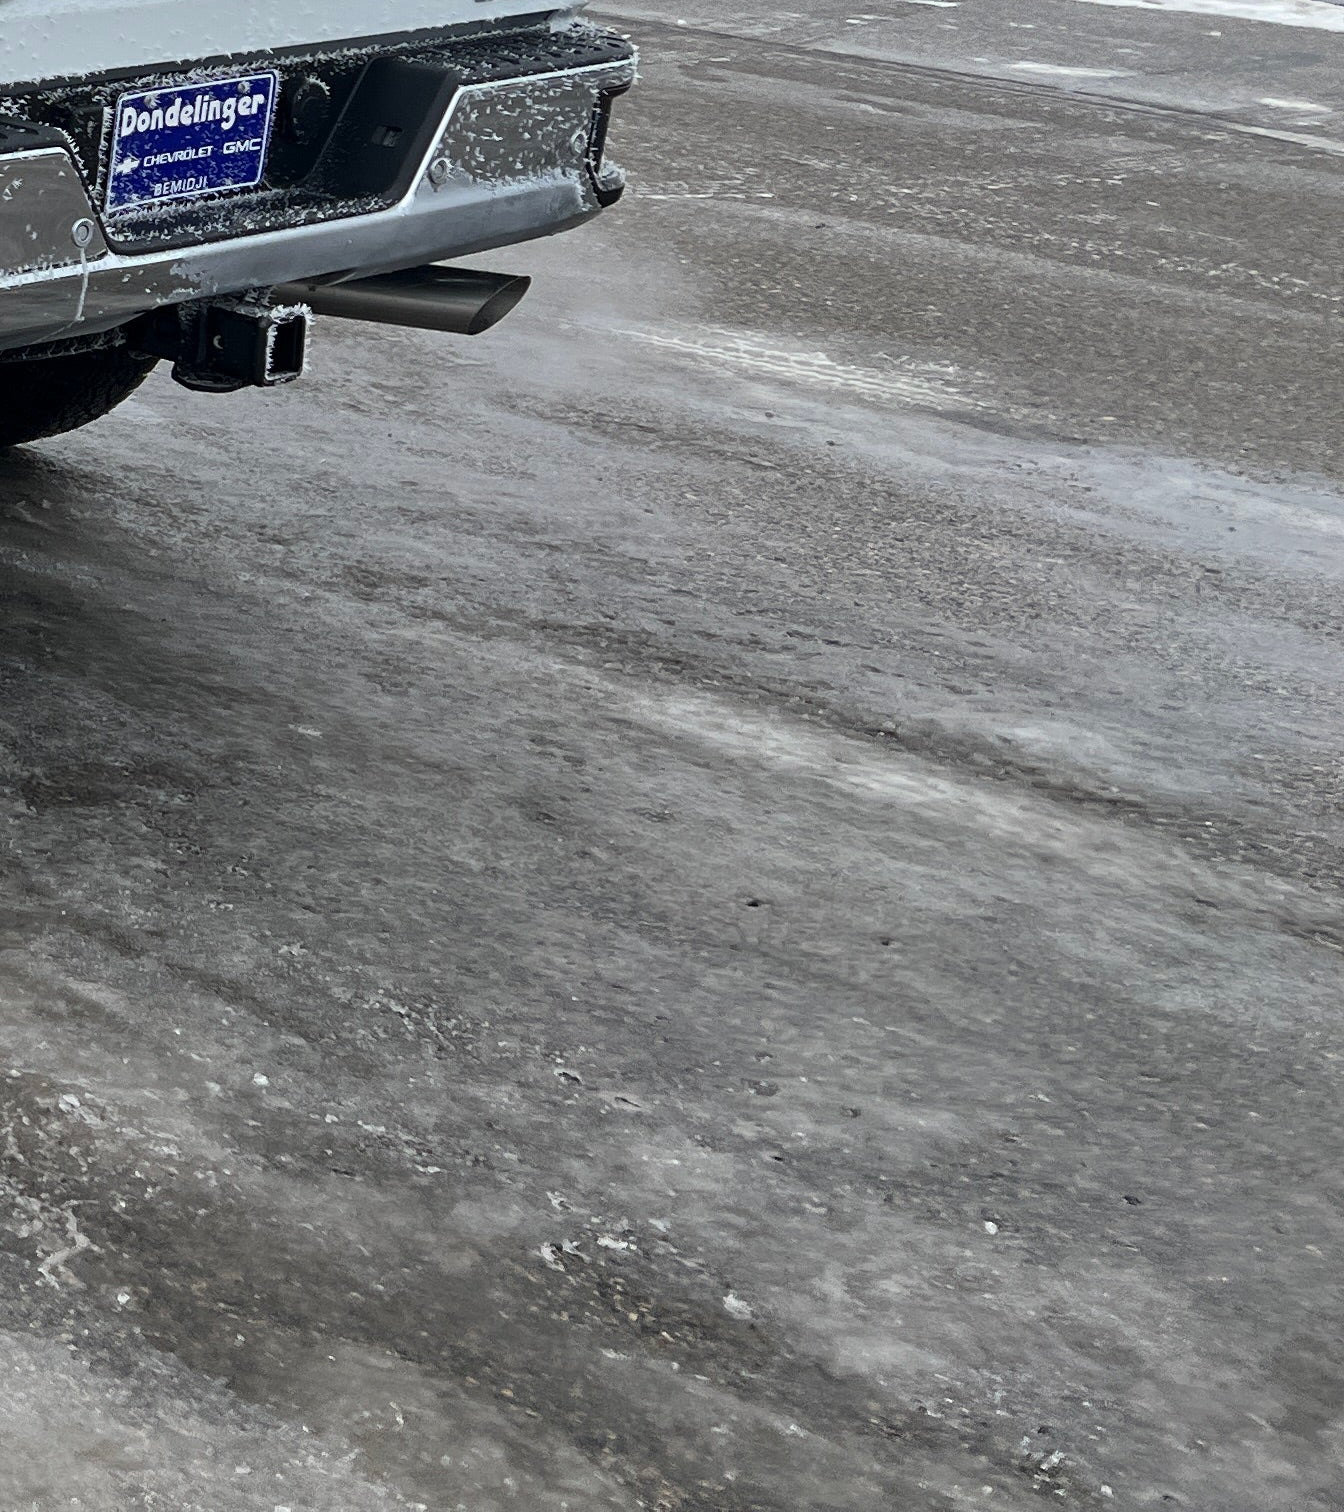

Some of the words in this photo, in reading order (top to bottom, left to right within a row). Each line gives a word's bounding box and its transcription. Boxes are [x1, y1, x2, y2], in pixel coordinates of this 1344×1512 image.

[120, 94, 265, 138] Dondelinger
[143, 145, 214, 167] CHEVROLET
[223, 138, 262, 155] GMC
[153, 175, 208, 197] BEMIDJI
